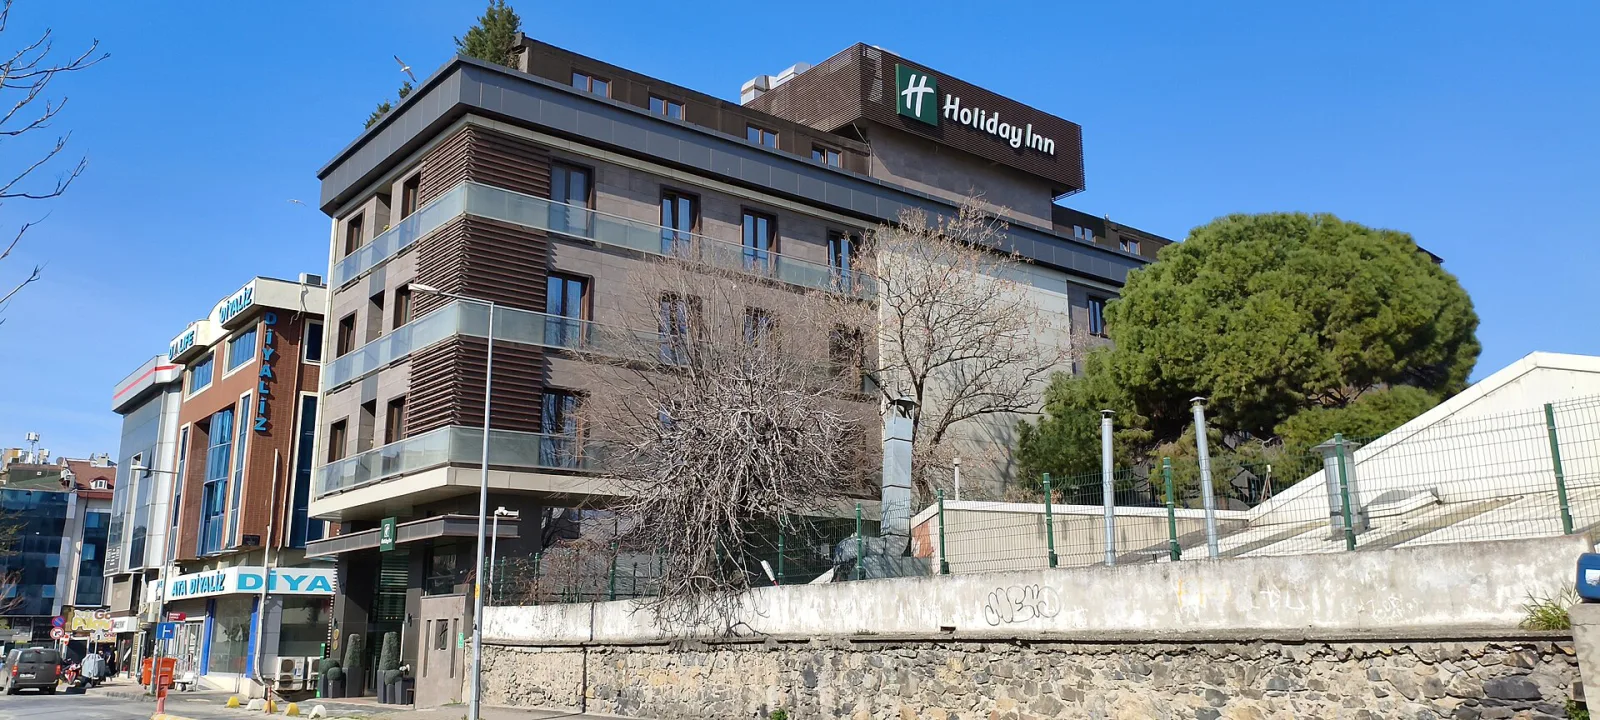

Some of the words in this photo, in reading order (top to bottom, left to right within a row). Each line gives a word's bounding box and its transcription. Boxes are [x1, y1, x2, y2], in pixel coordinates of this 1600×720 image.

[943, 94, 1022, 149] Holiday
[1025, 124, 1055, 155] Inn
[254, 312, 277, 431] DİYALİZ
[172, 580, 187, 596] ATA
[189, 571, 225, 594] DİYALİZ
